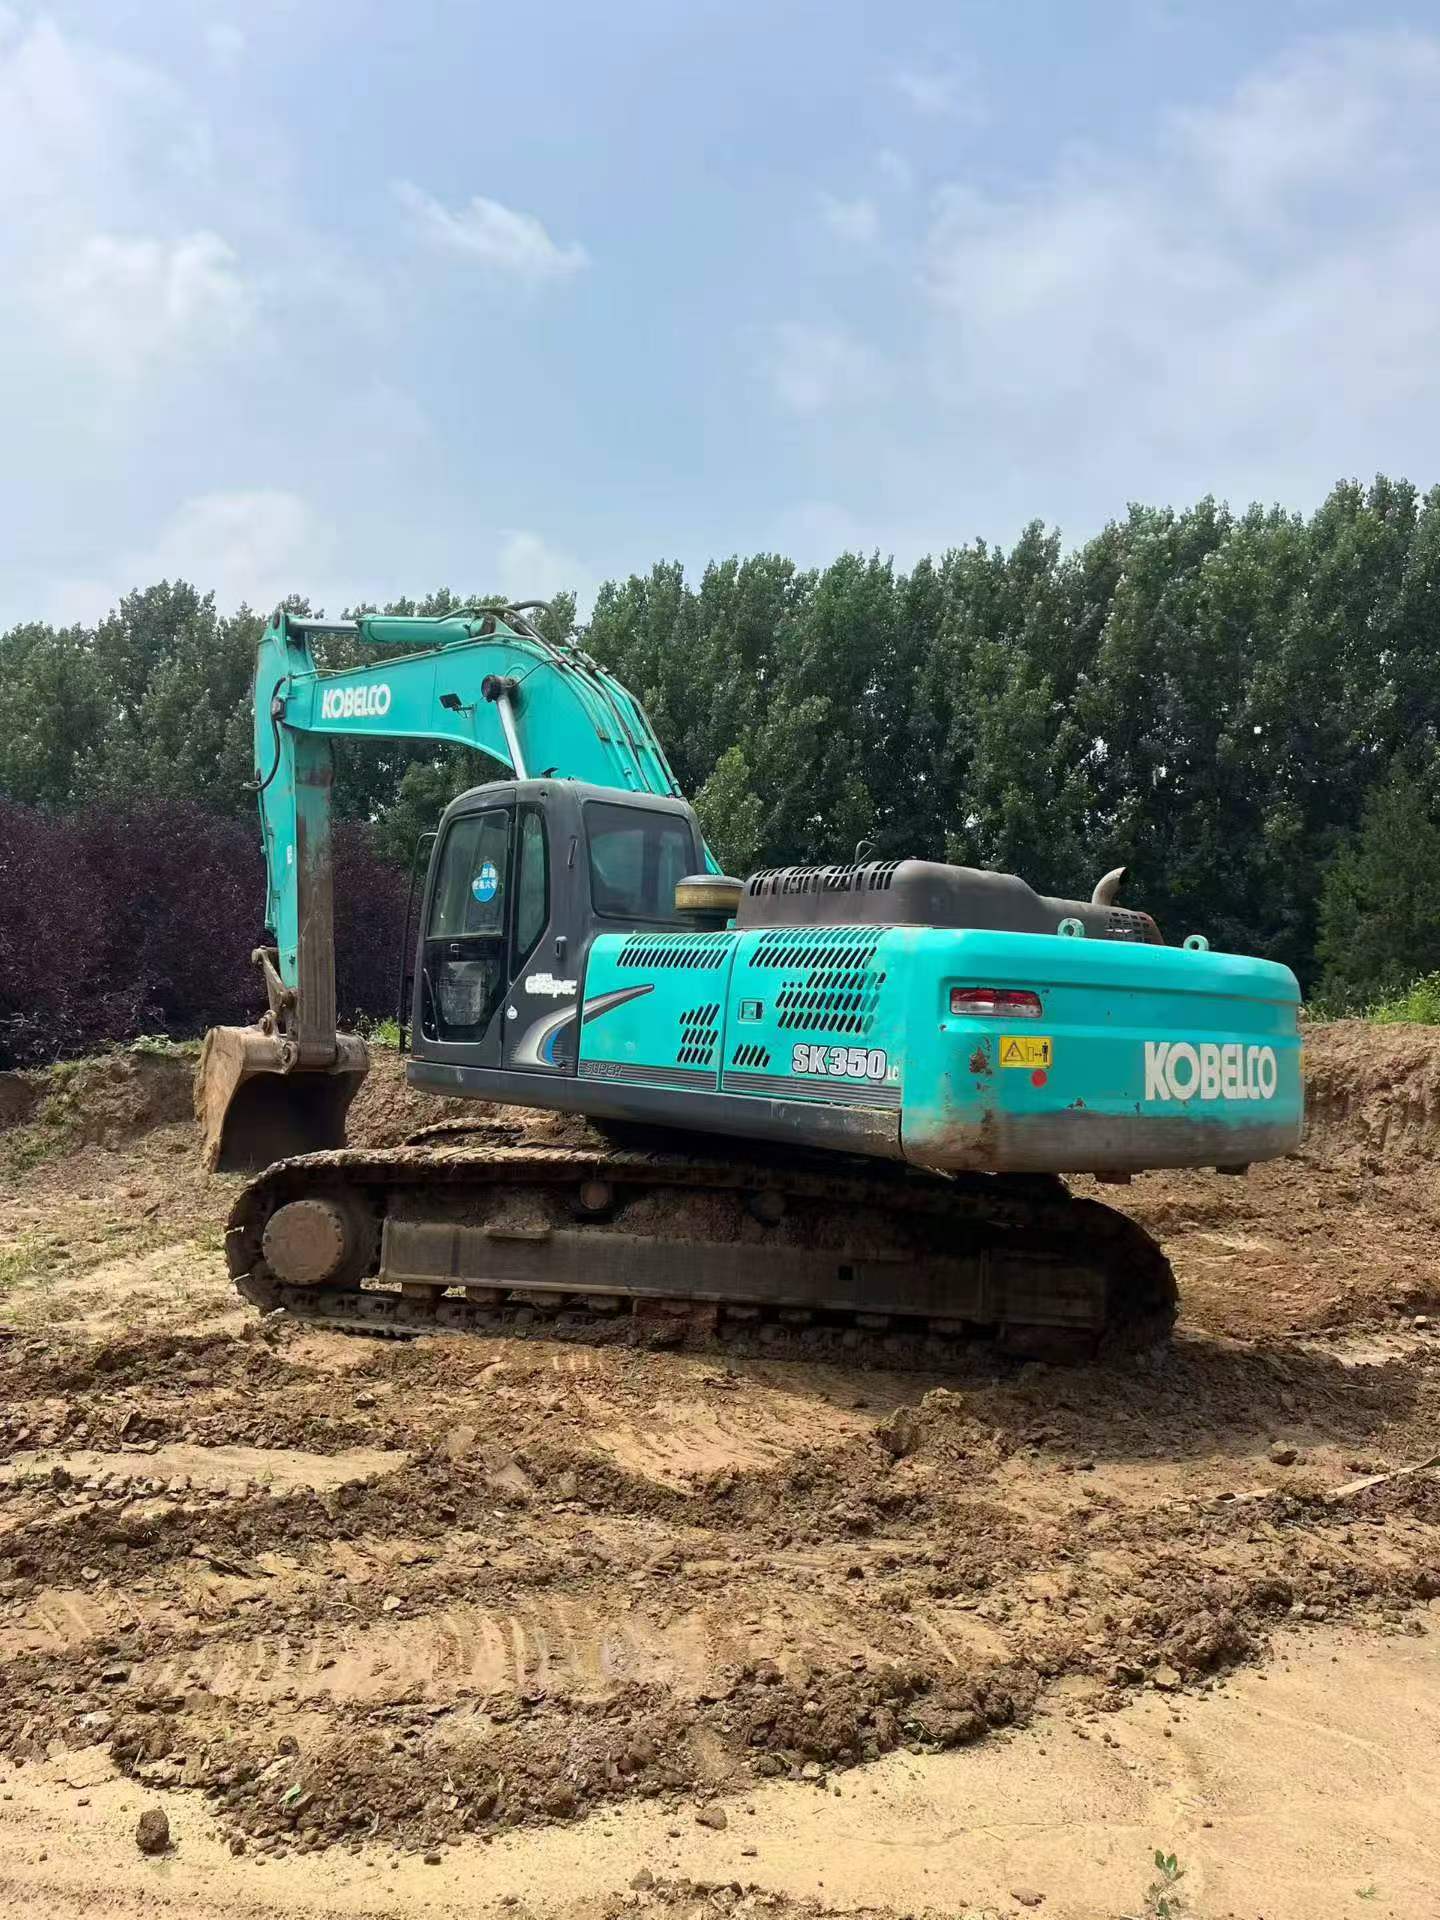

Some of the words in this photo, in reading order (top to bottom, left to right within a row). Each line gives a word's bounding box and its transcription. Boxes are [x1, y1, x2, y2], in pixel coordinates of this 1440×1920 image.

[321, 683, 391, 719] KOBELCO
[792, 1043, 887, 1080] SK350
[1144, 1041, 1277, 1100] KOBELCO
